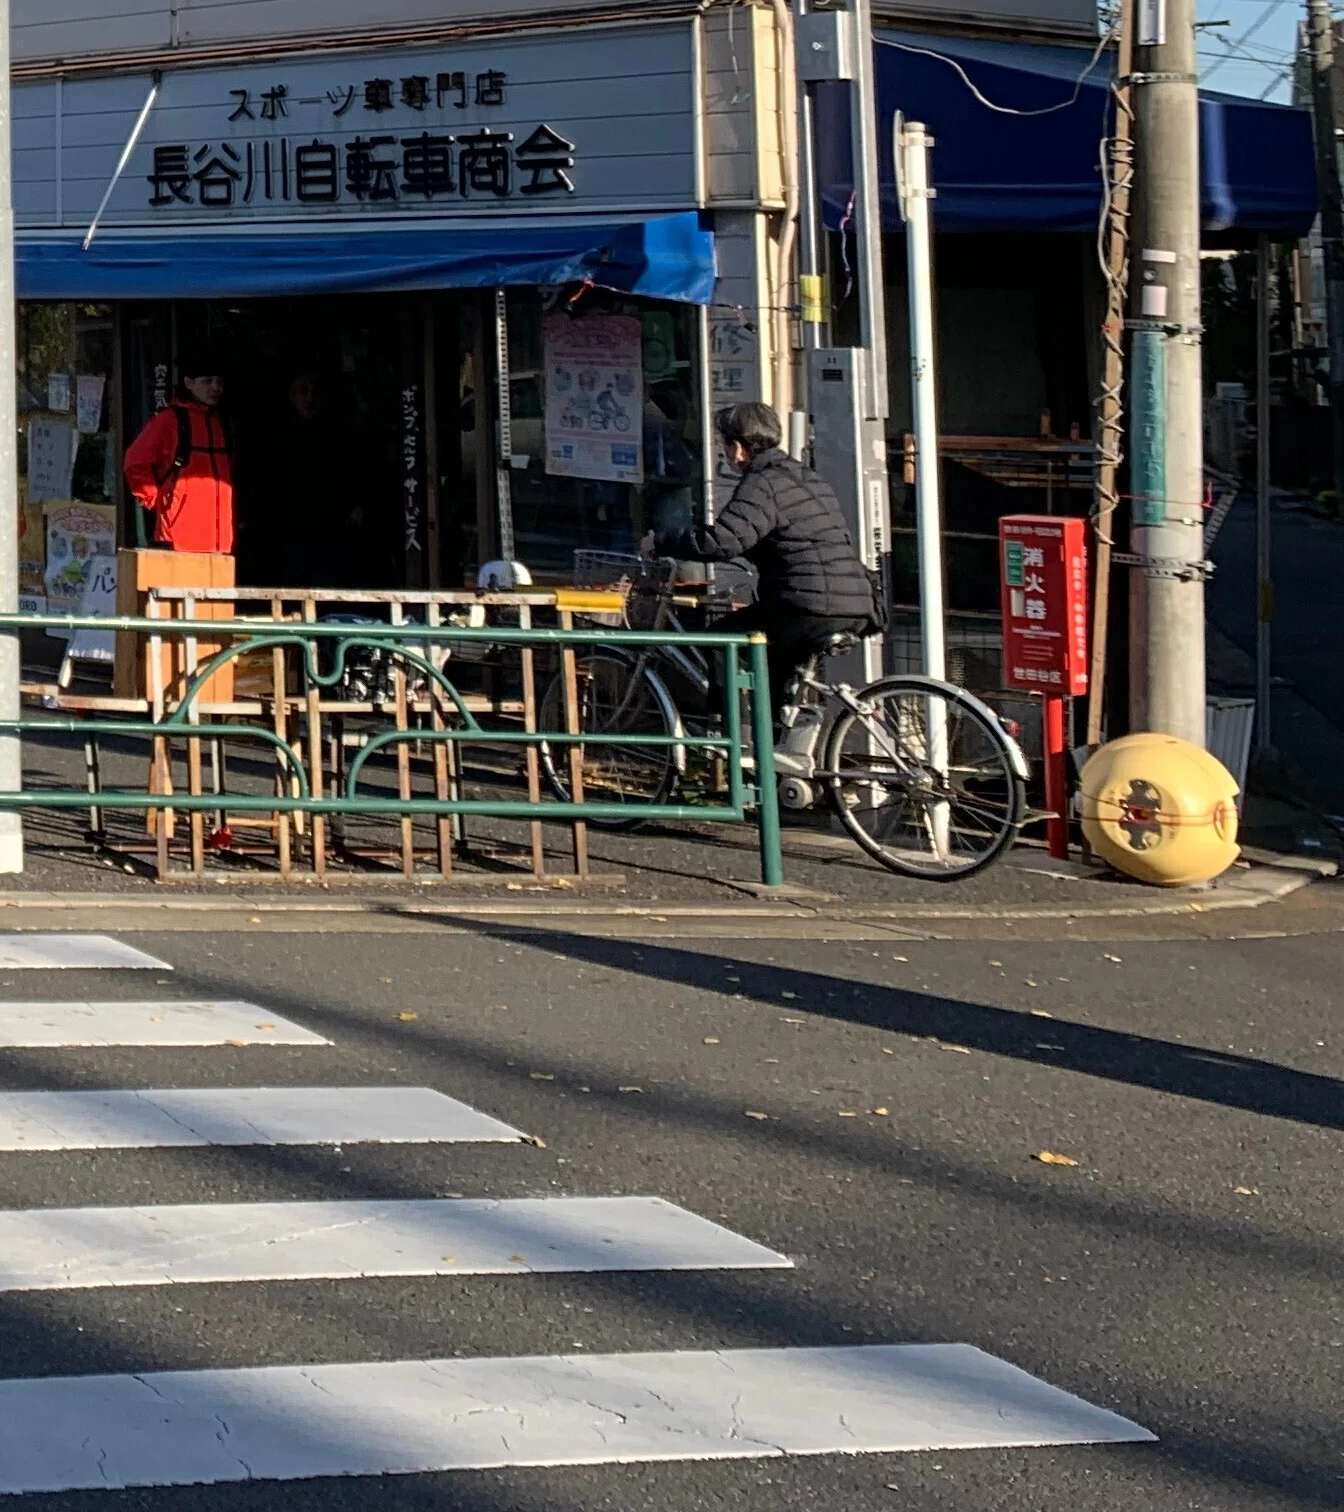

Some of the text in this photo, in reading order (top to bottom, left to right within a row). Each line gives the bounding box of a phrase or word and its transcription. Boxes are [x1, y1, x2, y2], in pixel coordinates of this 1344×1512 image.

[228, 69, 507, 122] スポーツ車専門店
[147, 123, 576, 206] 長谷川自転車商会
[1023, 547, 1047, 620] 消火器
